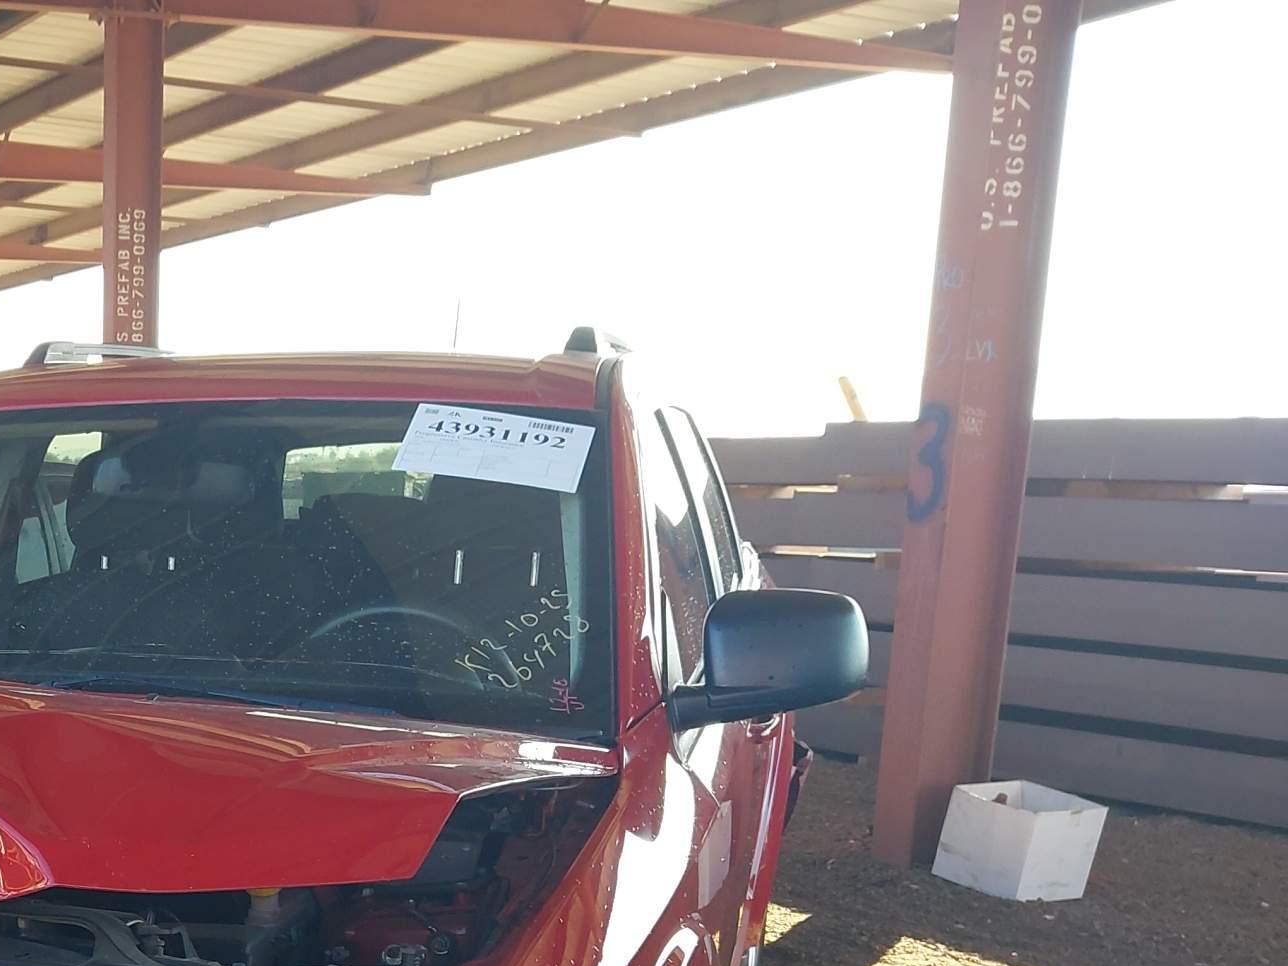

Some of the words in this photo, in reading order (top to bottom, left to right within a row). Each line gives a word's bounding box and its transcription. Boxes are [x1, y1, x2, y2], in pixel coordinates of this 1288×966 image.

[118, 207, 131, 240] INC.
[116, 249, 131, 317] PREFAB
[132, 208, 146, 343] 866-799-0969
[427, 419, 567, 449] 43931192
[903, 403, 952, 522] 3
